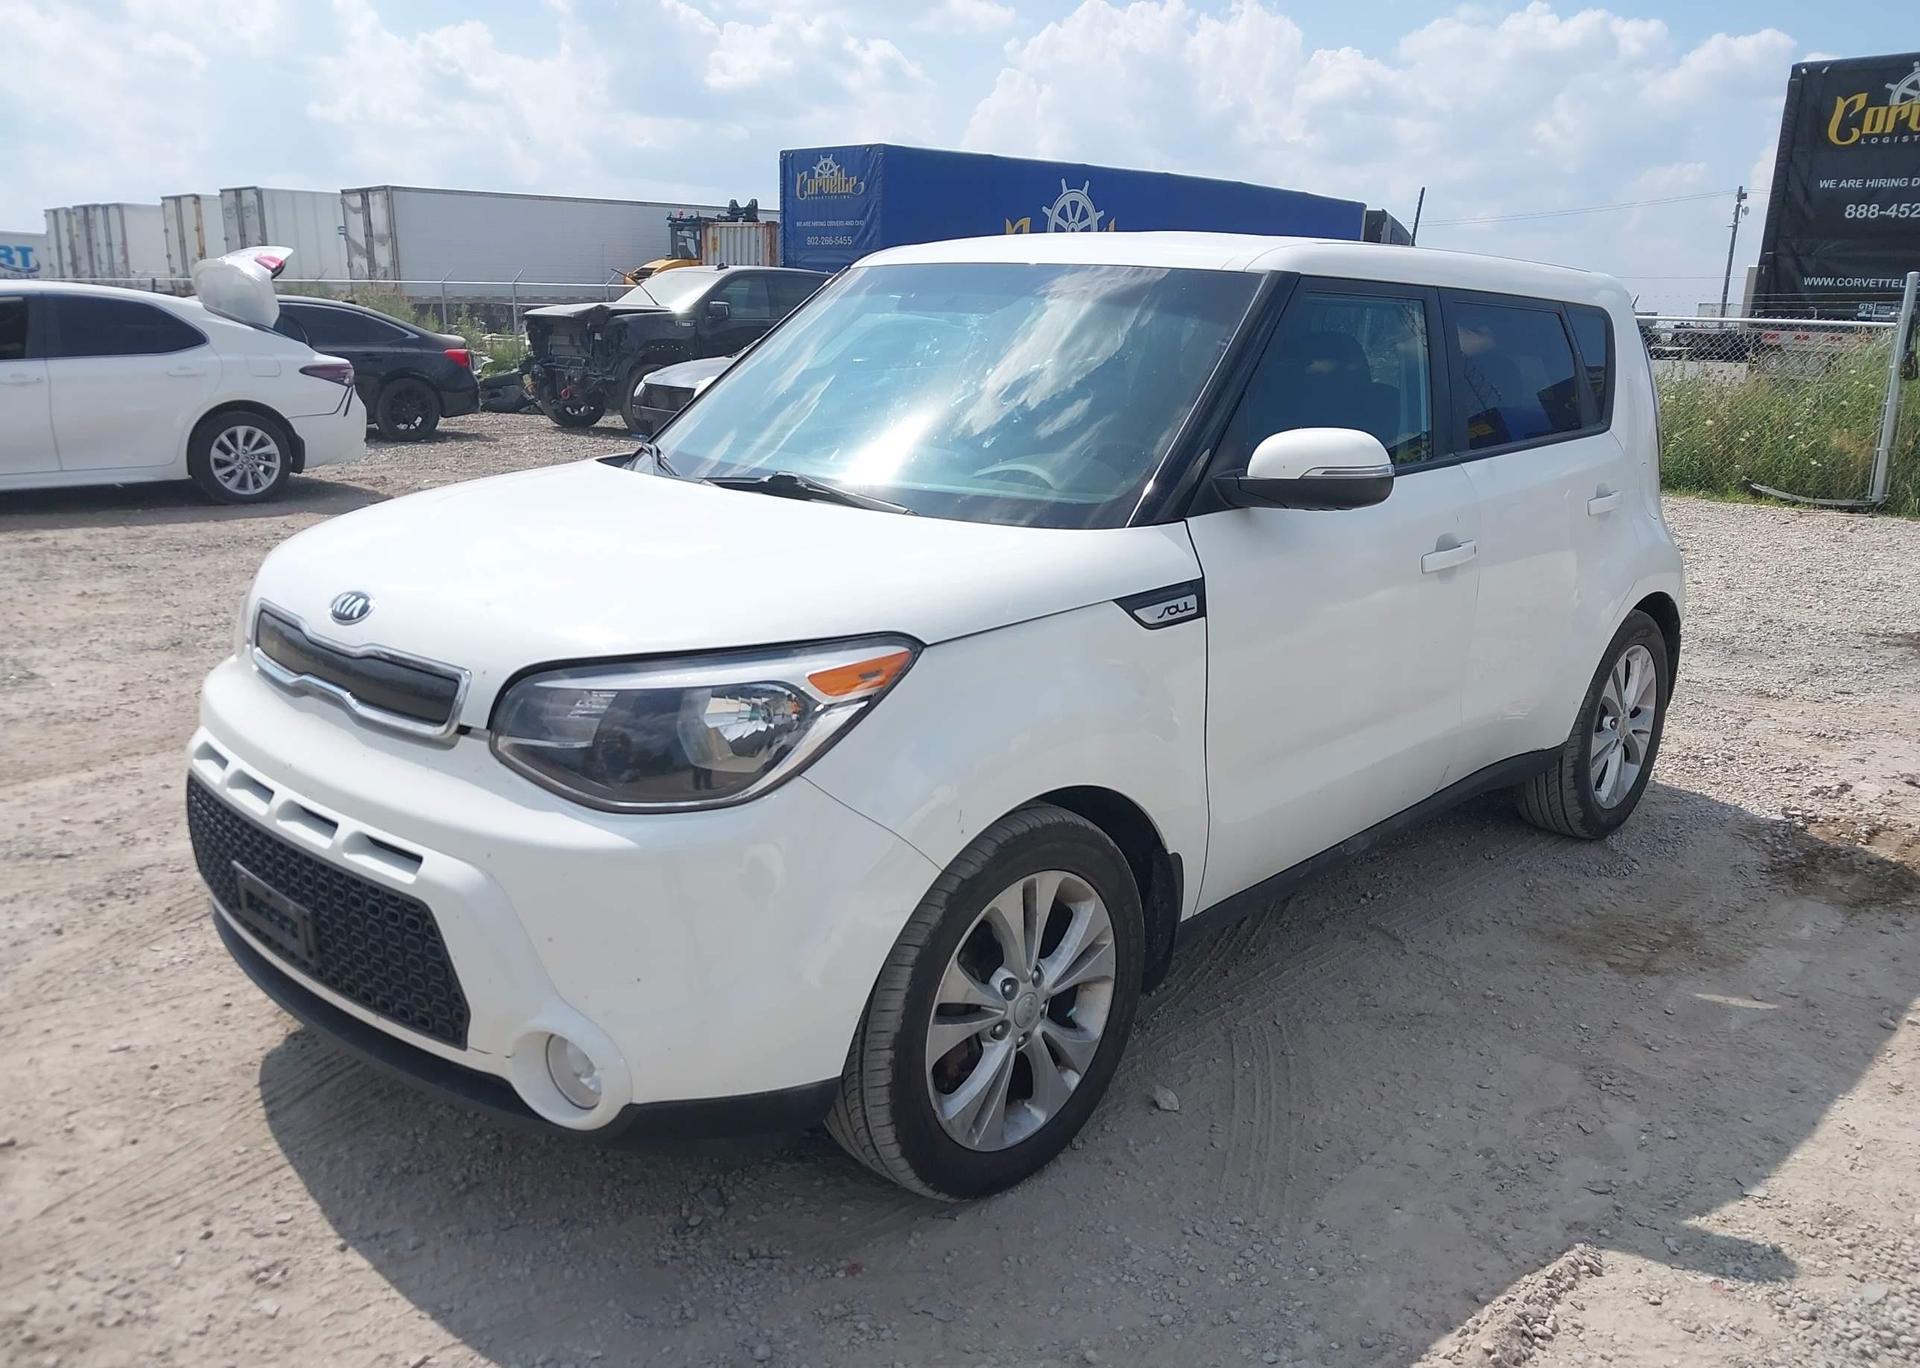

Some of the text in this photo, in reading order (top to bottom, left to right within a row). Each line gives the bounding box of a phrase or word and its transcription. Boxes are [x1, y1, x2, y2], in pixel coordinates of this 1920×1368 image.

[796, 167, 865, 201] Corvette
[1819, 179, 1837, 188] WE
[1838, 178, 1864, 188] ARE
[1865, 177, 1909, 188] HIRING
[1844, 202, 1920, 219] 888-452
[1157, 601, 1195, 620] SOUL
